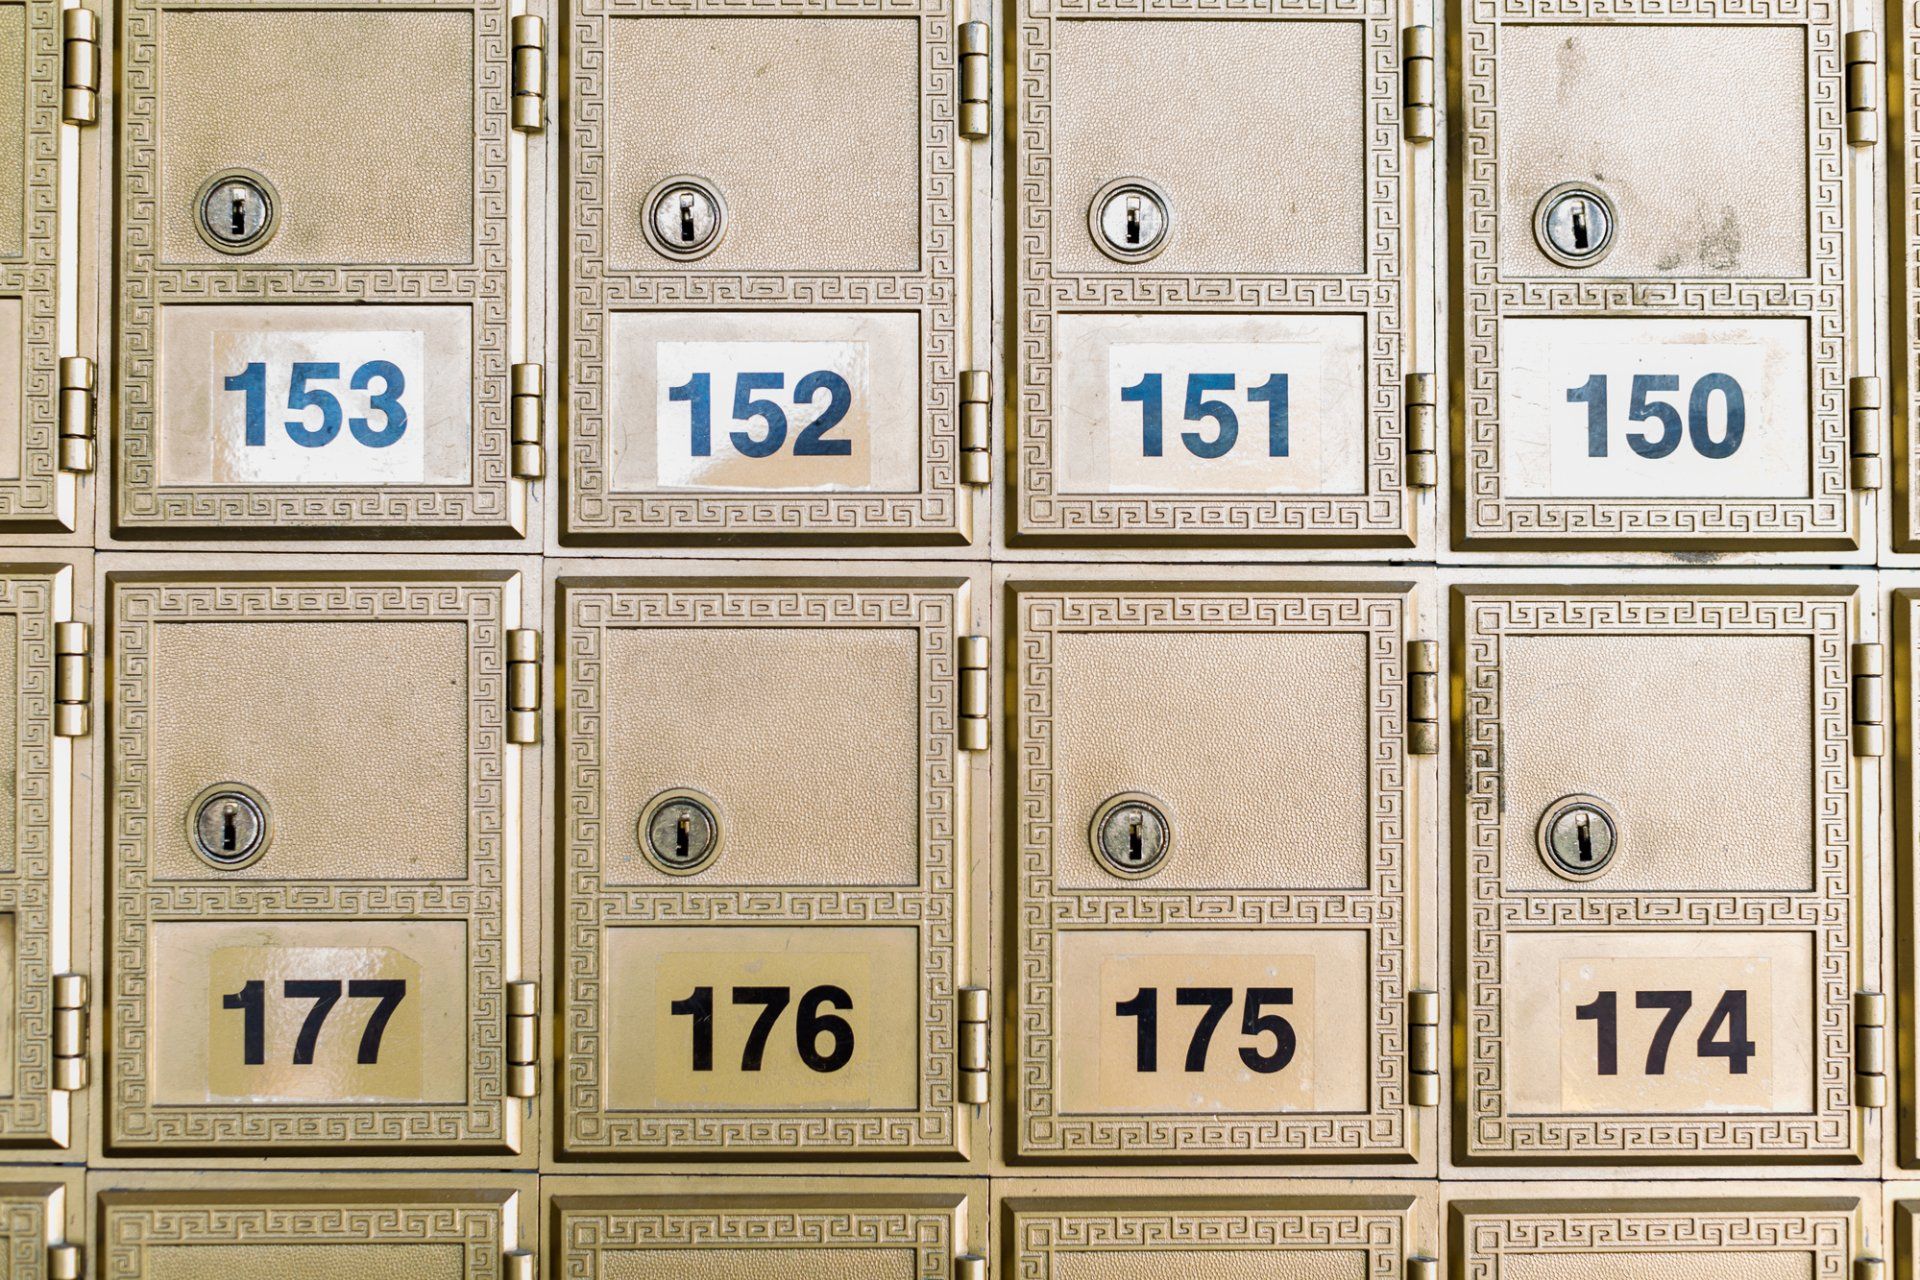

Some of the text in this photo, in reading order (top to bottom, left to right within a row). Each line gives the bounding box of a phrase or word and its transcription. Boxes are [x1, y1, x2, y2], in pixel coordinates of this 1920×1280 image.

[225, 361, 407, 447] 153
[670, 371, 851, 458] 152
[1121, 374, 1288, 458] 151
[1567, 373, 1745, 459] 150
[223, 979, 406, 1065] 177
[671, 985, 854, 1073] 176
[1116, 987, 1296, 1074] 175
[1576, 990, 1755, 1075] 174
